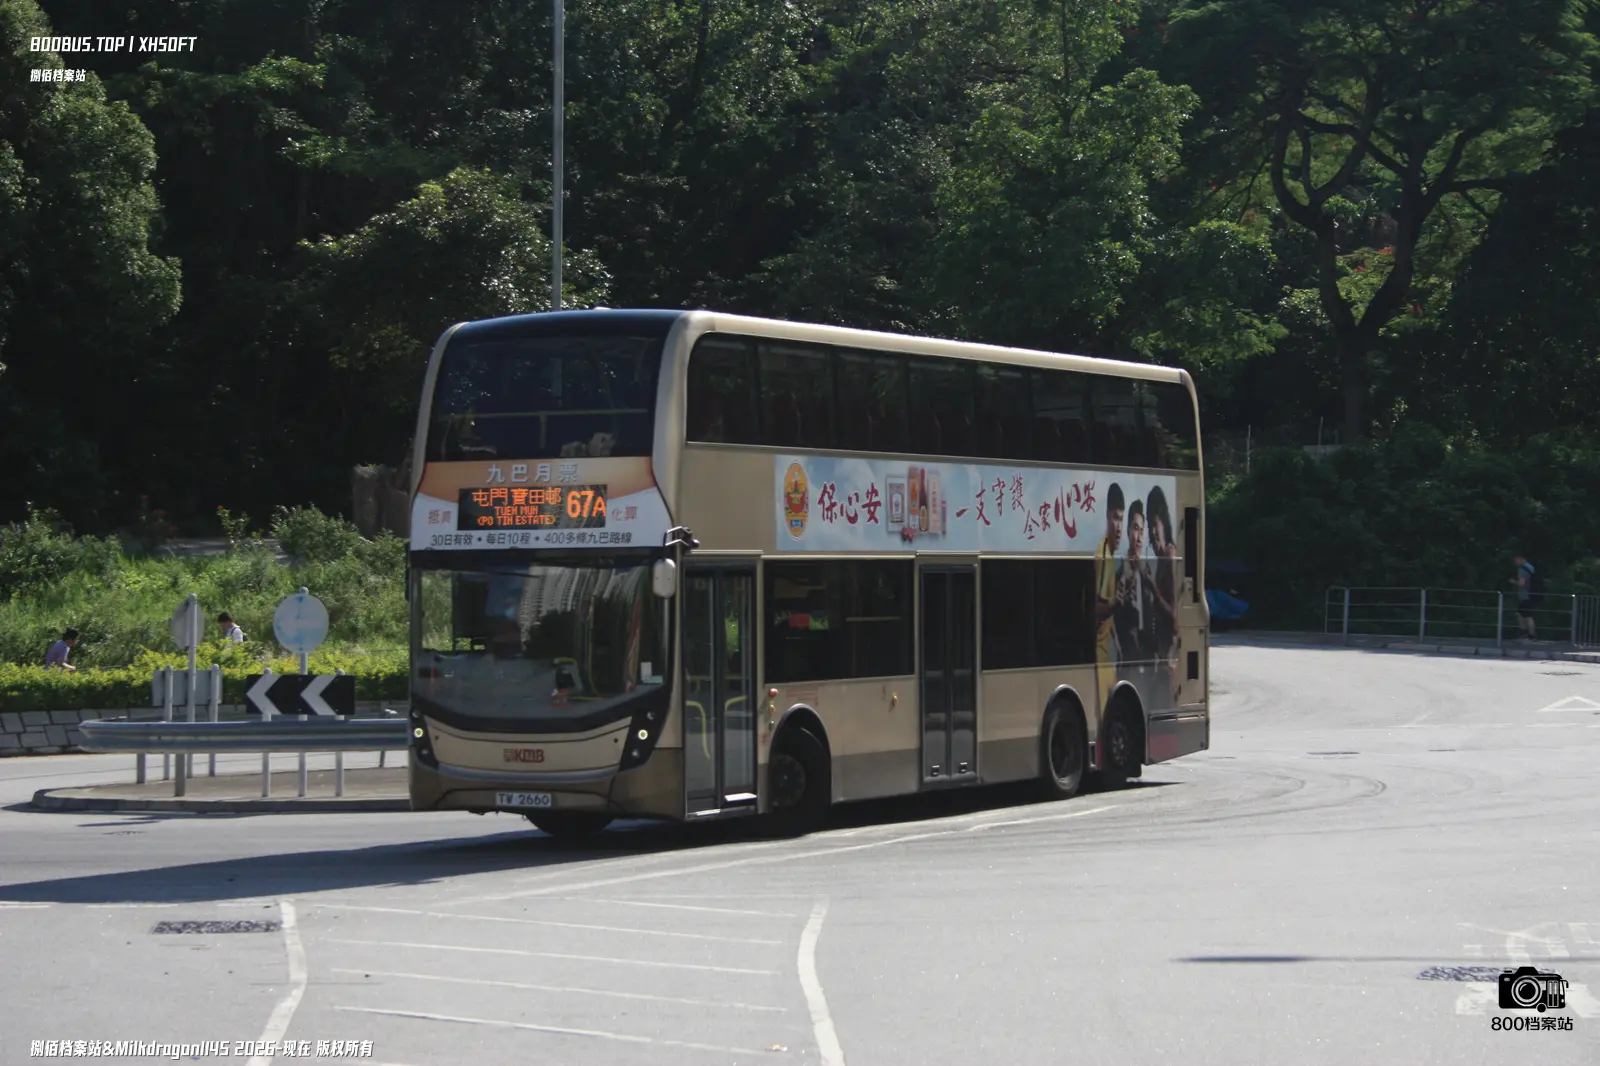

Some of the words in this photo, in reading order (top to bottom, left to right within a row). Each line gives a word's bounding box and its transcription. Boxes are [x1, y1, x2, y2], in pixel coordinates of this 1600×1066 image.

[486, 463, 579, 483] 九巴月票
[567, 490, 606, 518] 67A
[817, 481, 882, 525] 保心安
[956, 473, 1025, 526] 一支守護
[495, 506, 517, 515] TUEN
[520, 506, 539, 515] MUN
[496, 516, 513, 525] TIN
[515, 515, 556, 525] ESTATE)
[431, 533, 473, 546] 30日有效
[486, 532, 531, 545] 每日10程
[544, 532, 632, 544] 400多條九巴路線
[499, 793, 513, 805] TW
[518, 794, 550, 806] 2660
